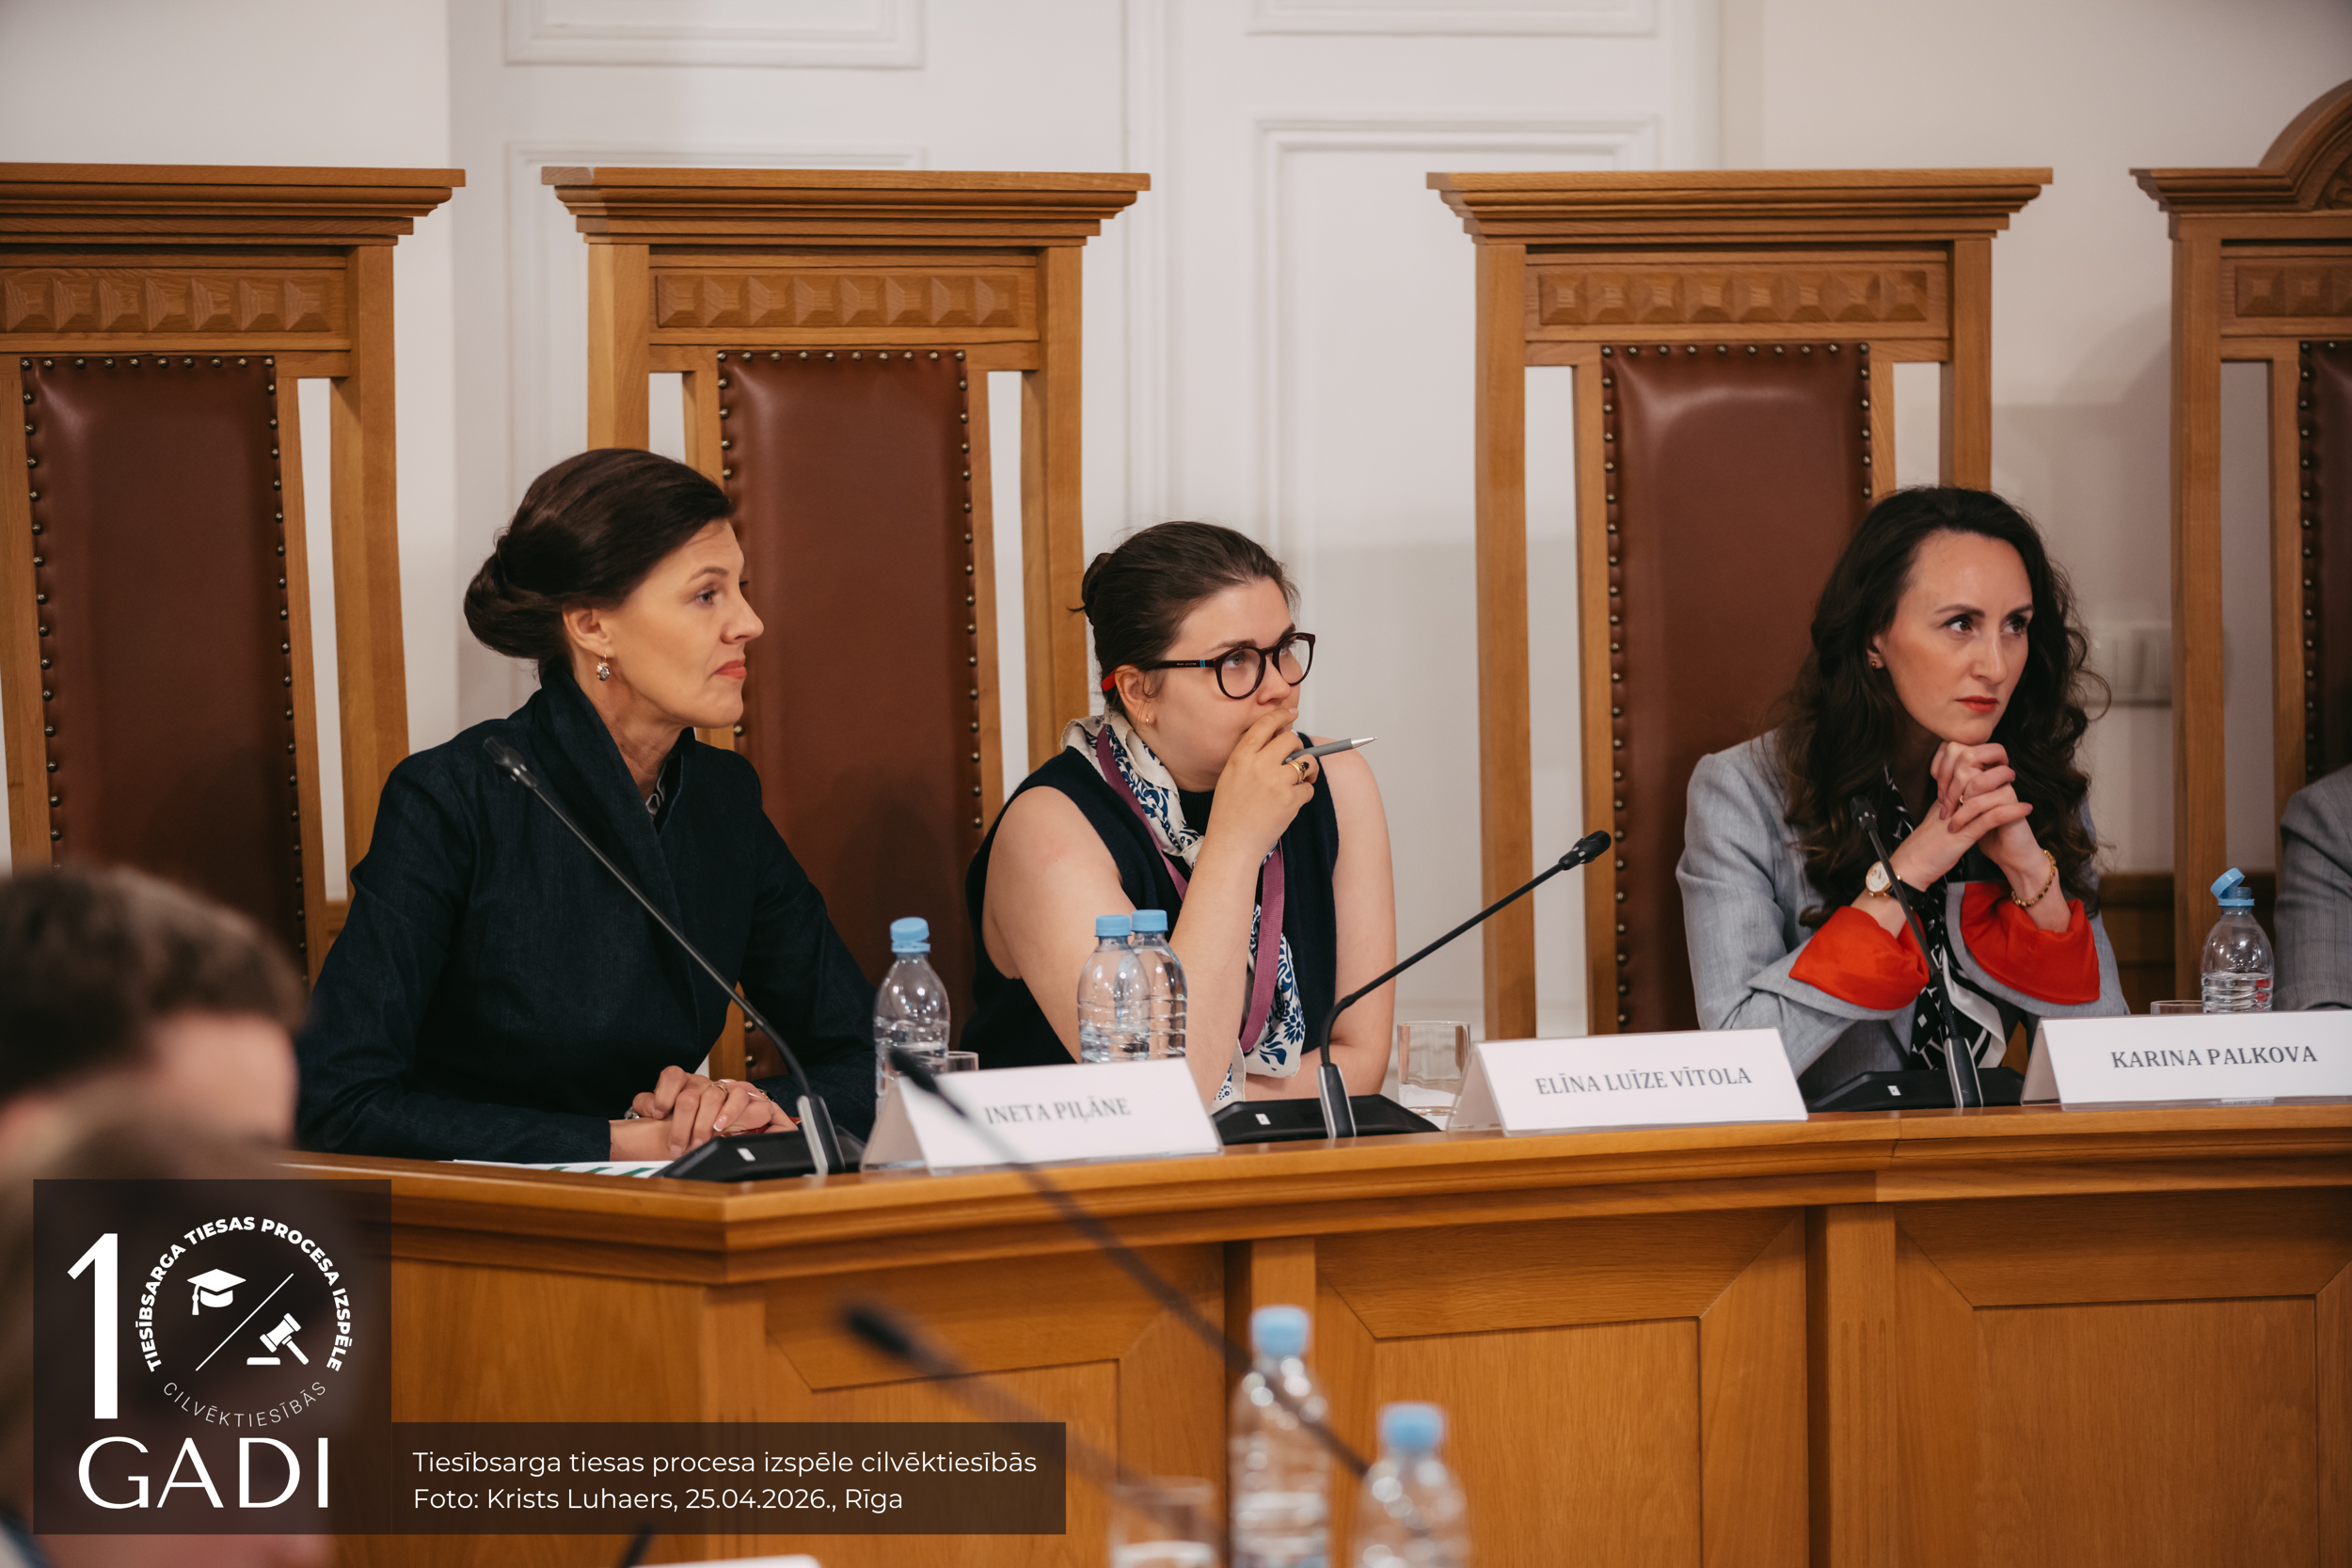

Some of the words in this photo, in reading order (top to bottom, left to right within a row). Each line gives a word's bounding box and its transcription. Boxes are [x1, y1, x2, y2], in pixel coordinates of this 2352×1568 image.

[2110, 1049, 2203, 1069] KARINA
[2206, 1045, 2318, 1066] PALKOVA
[1534, 1072, 1601, 1095] ELĪNA
[1603, 1069, 1669, 1092] LUĪZE
[1670, 1066, 1753, 1087] VĪTOLA
[984, 1103, 1051, 1124] INETA
[1054, 1095, 1132, 1123] PIĻĀNE
